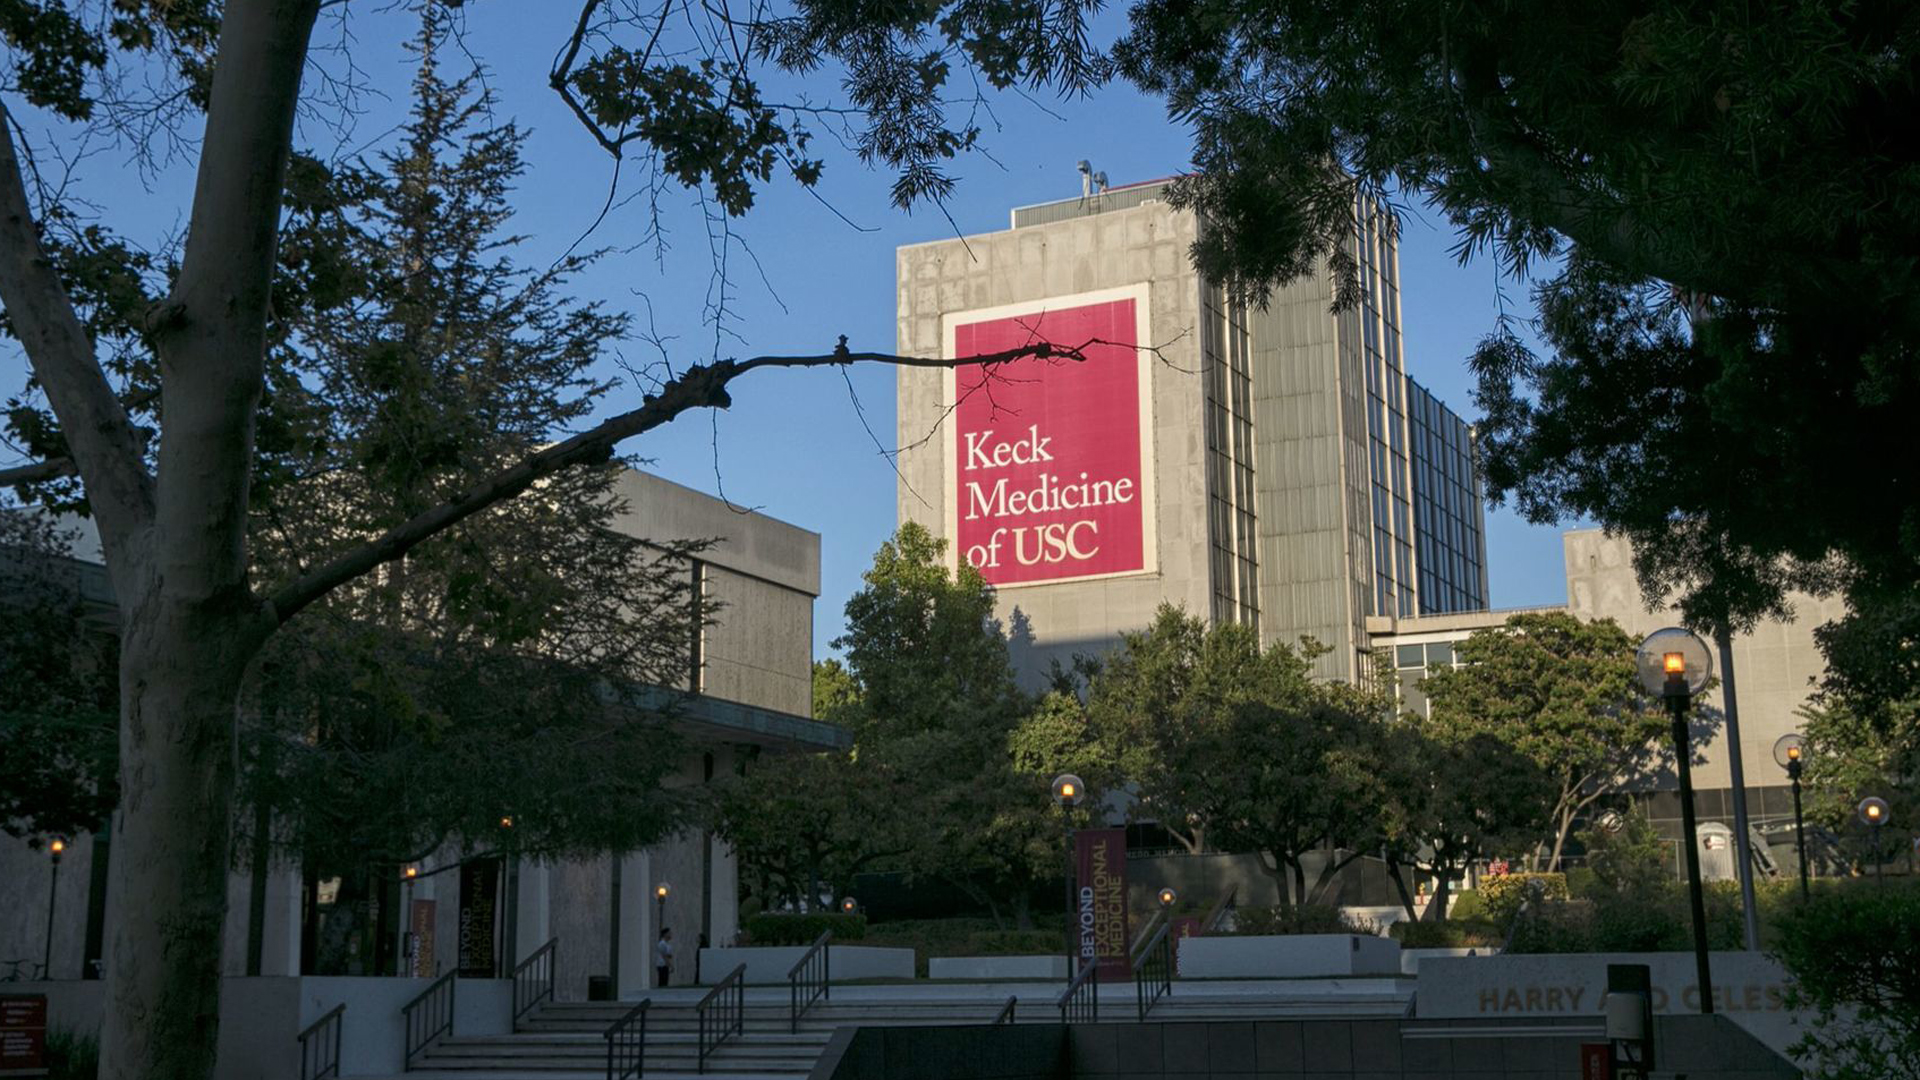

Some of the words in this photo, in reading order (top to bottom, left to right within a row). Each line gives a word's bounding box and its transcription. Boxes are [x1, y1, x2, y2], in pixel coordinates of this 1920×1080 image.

[964, 425, 1054, 471] Keck
[965, 472, 1134, 521] Medicine
[966, 528, 1006, 568] of
[1012, 520, 1099, 565] USC
[470, 868, 484, 969] EXCEPTIONAL
[1080, 886, 1095, 959] BEYOND
[1092, 839, 1110, 958] EXCEPTIONAL
[1108, 876, 1125, 957] MEDICINE
[460, 907, 473, 970] BEYOND
[482, 901, 494, 969] MEDICINE
[1478, 986, 1585, 1013] HARRY
[1682, 985, 1783, 1012] CELES
